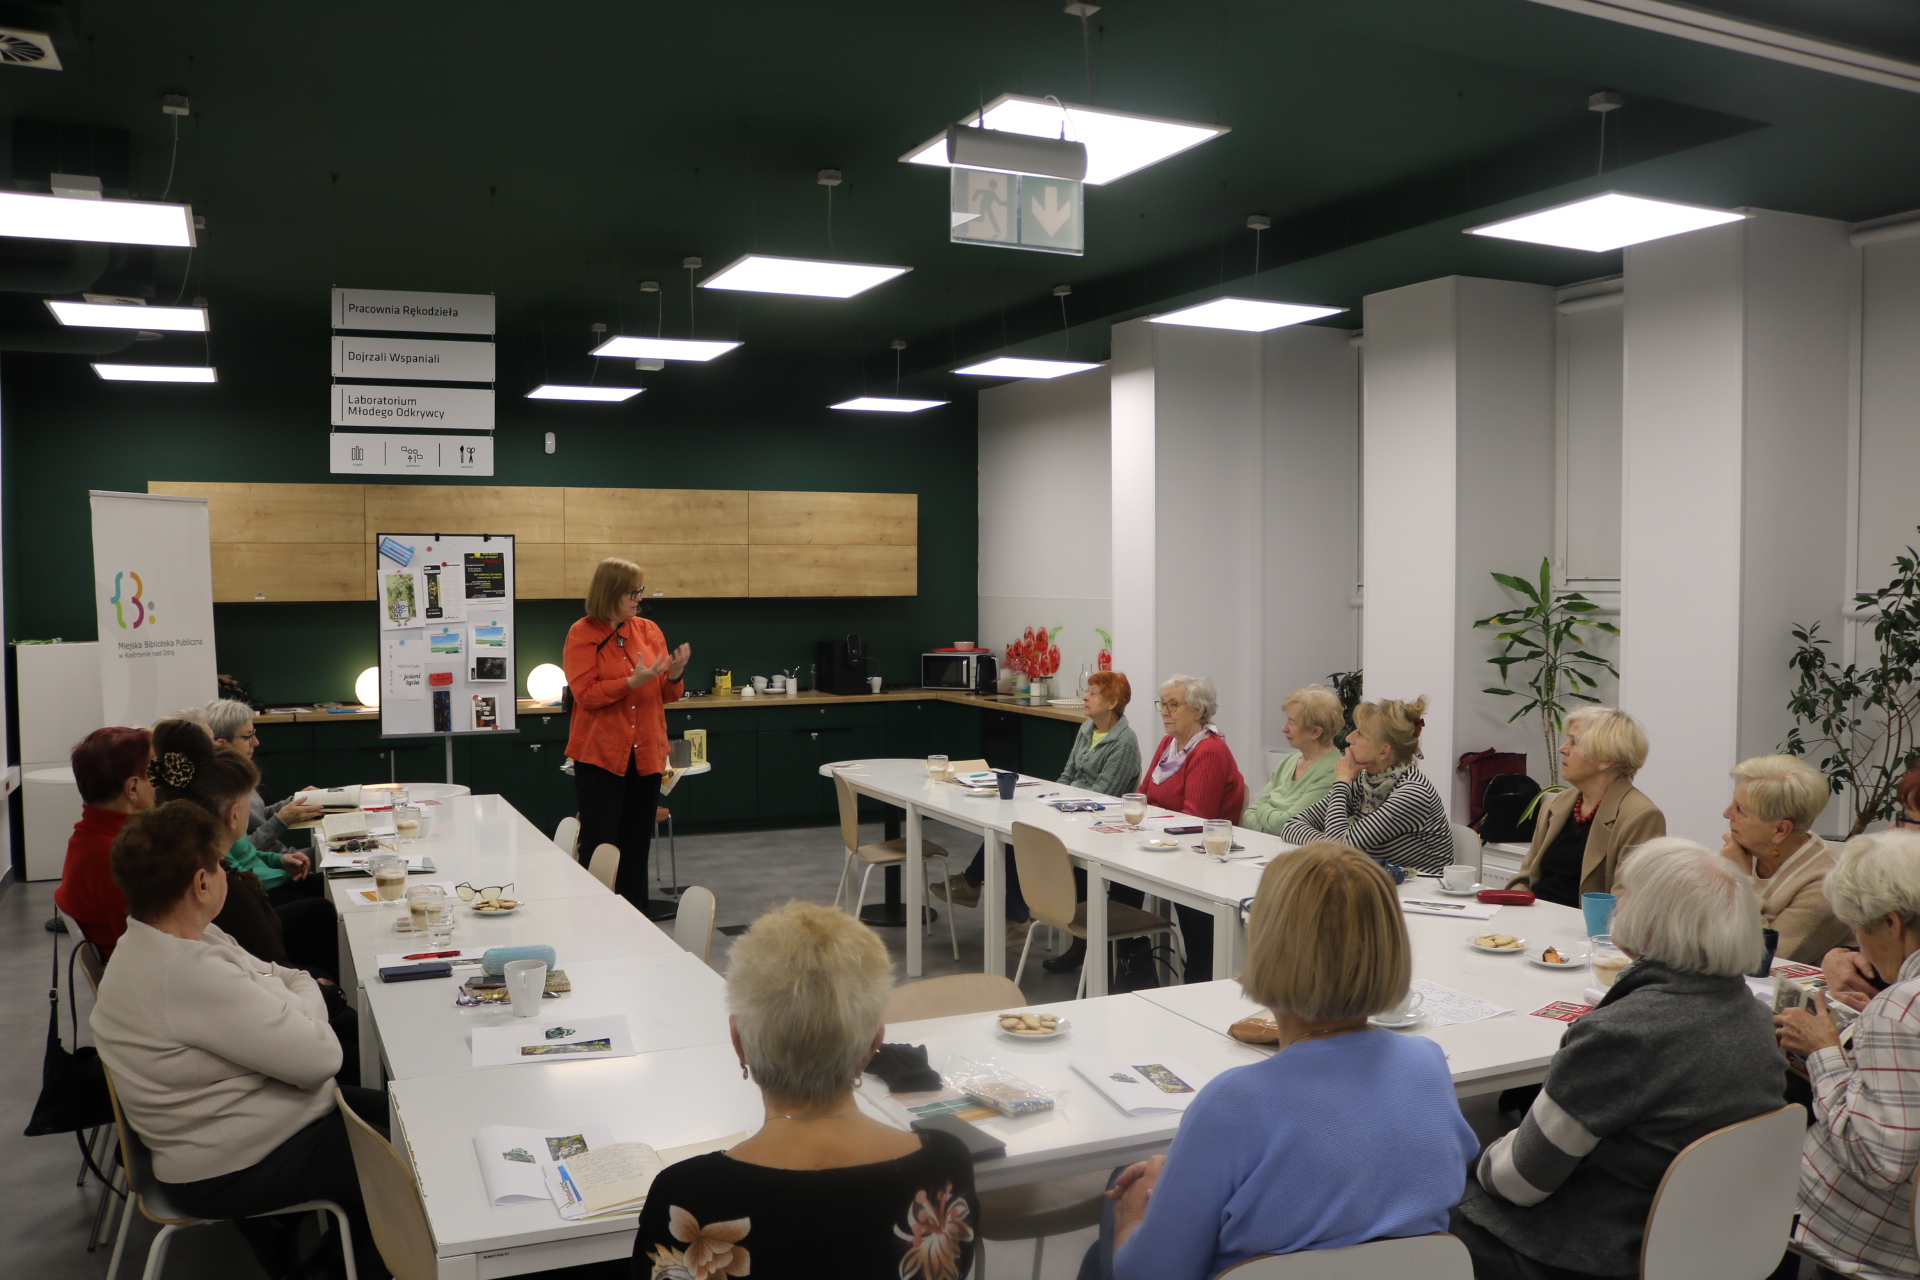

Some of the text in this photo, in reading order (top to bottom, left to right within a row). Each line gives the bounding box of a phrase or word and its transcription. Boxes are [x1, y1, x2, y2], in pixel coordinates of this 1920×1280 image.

[348, 303, 459, 317] Pracownia Rękodzieła
[348, 351, 440, 365] Dojrzali Wspaniali
[348, 395, 417, 406] Laboratorium
[348, 406, 445, 420] Młodego Odkrywcy
[118, 639, 203, 651] Miejska Biblioteka Publiczna
[125, 651, 151, 659] Kostrzynie
[163, 649, 175, 657] Odrą
[403, 672, 421, 681] jesieni
